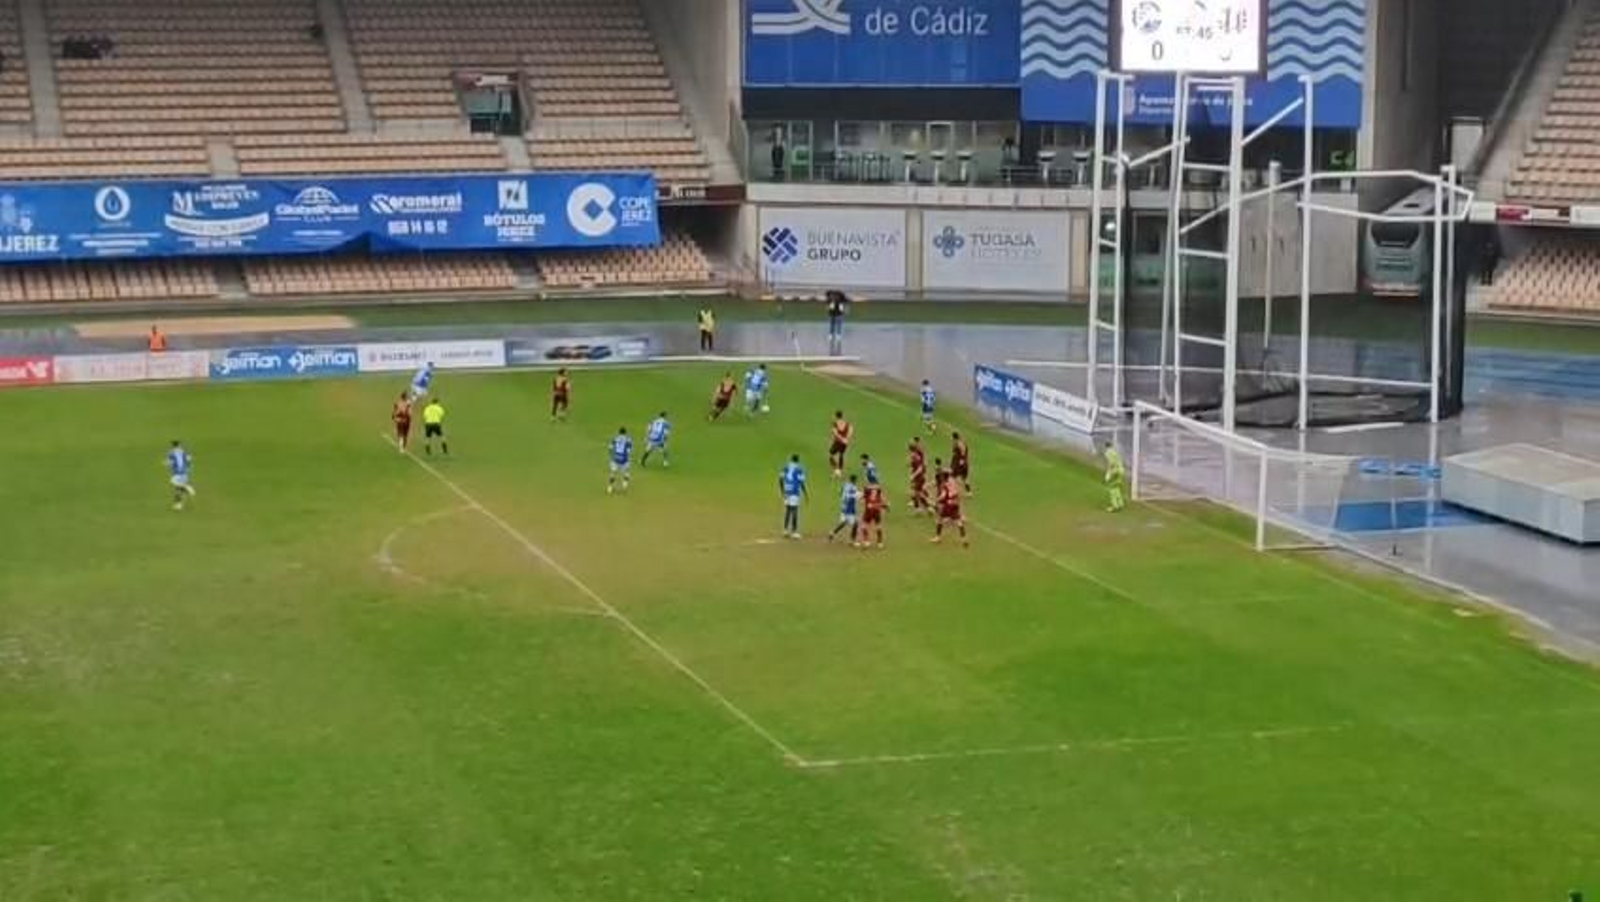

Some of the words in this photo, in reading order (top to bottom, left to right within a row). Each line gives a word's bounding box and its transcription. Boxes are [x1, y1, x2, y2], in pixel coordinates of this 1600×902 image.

[865, 6, 899, 35] de
[911, 6, 989, 35] Cádiz
[1152, 40, 1163, 61] 0
[619, 196, 650, 209] COPE
[621, 209, 652, 222] JEREZ
[807, 230, 898, 247] BUENAVISTA
[807, 248, 862, 262] GRUPO
